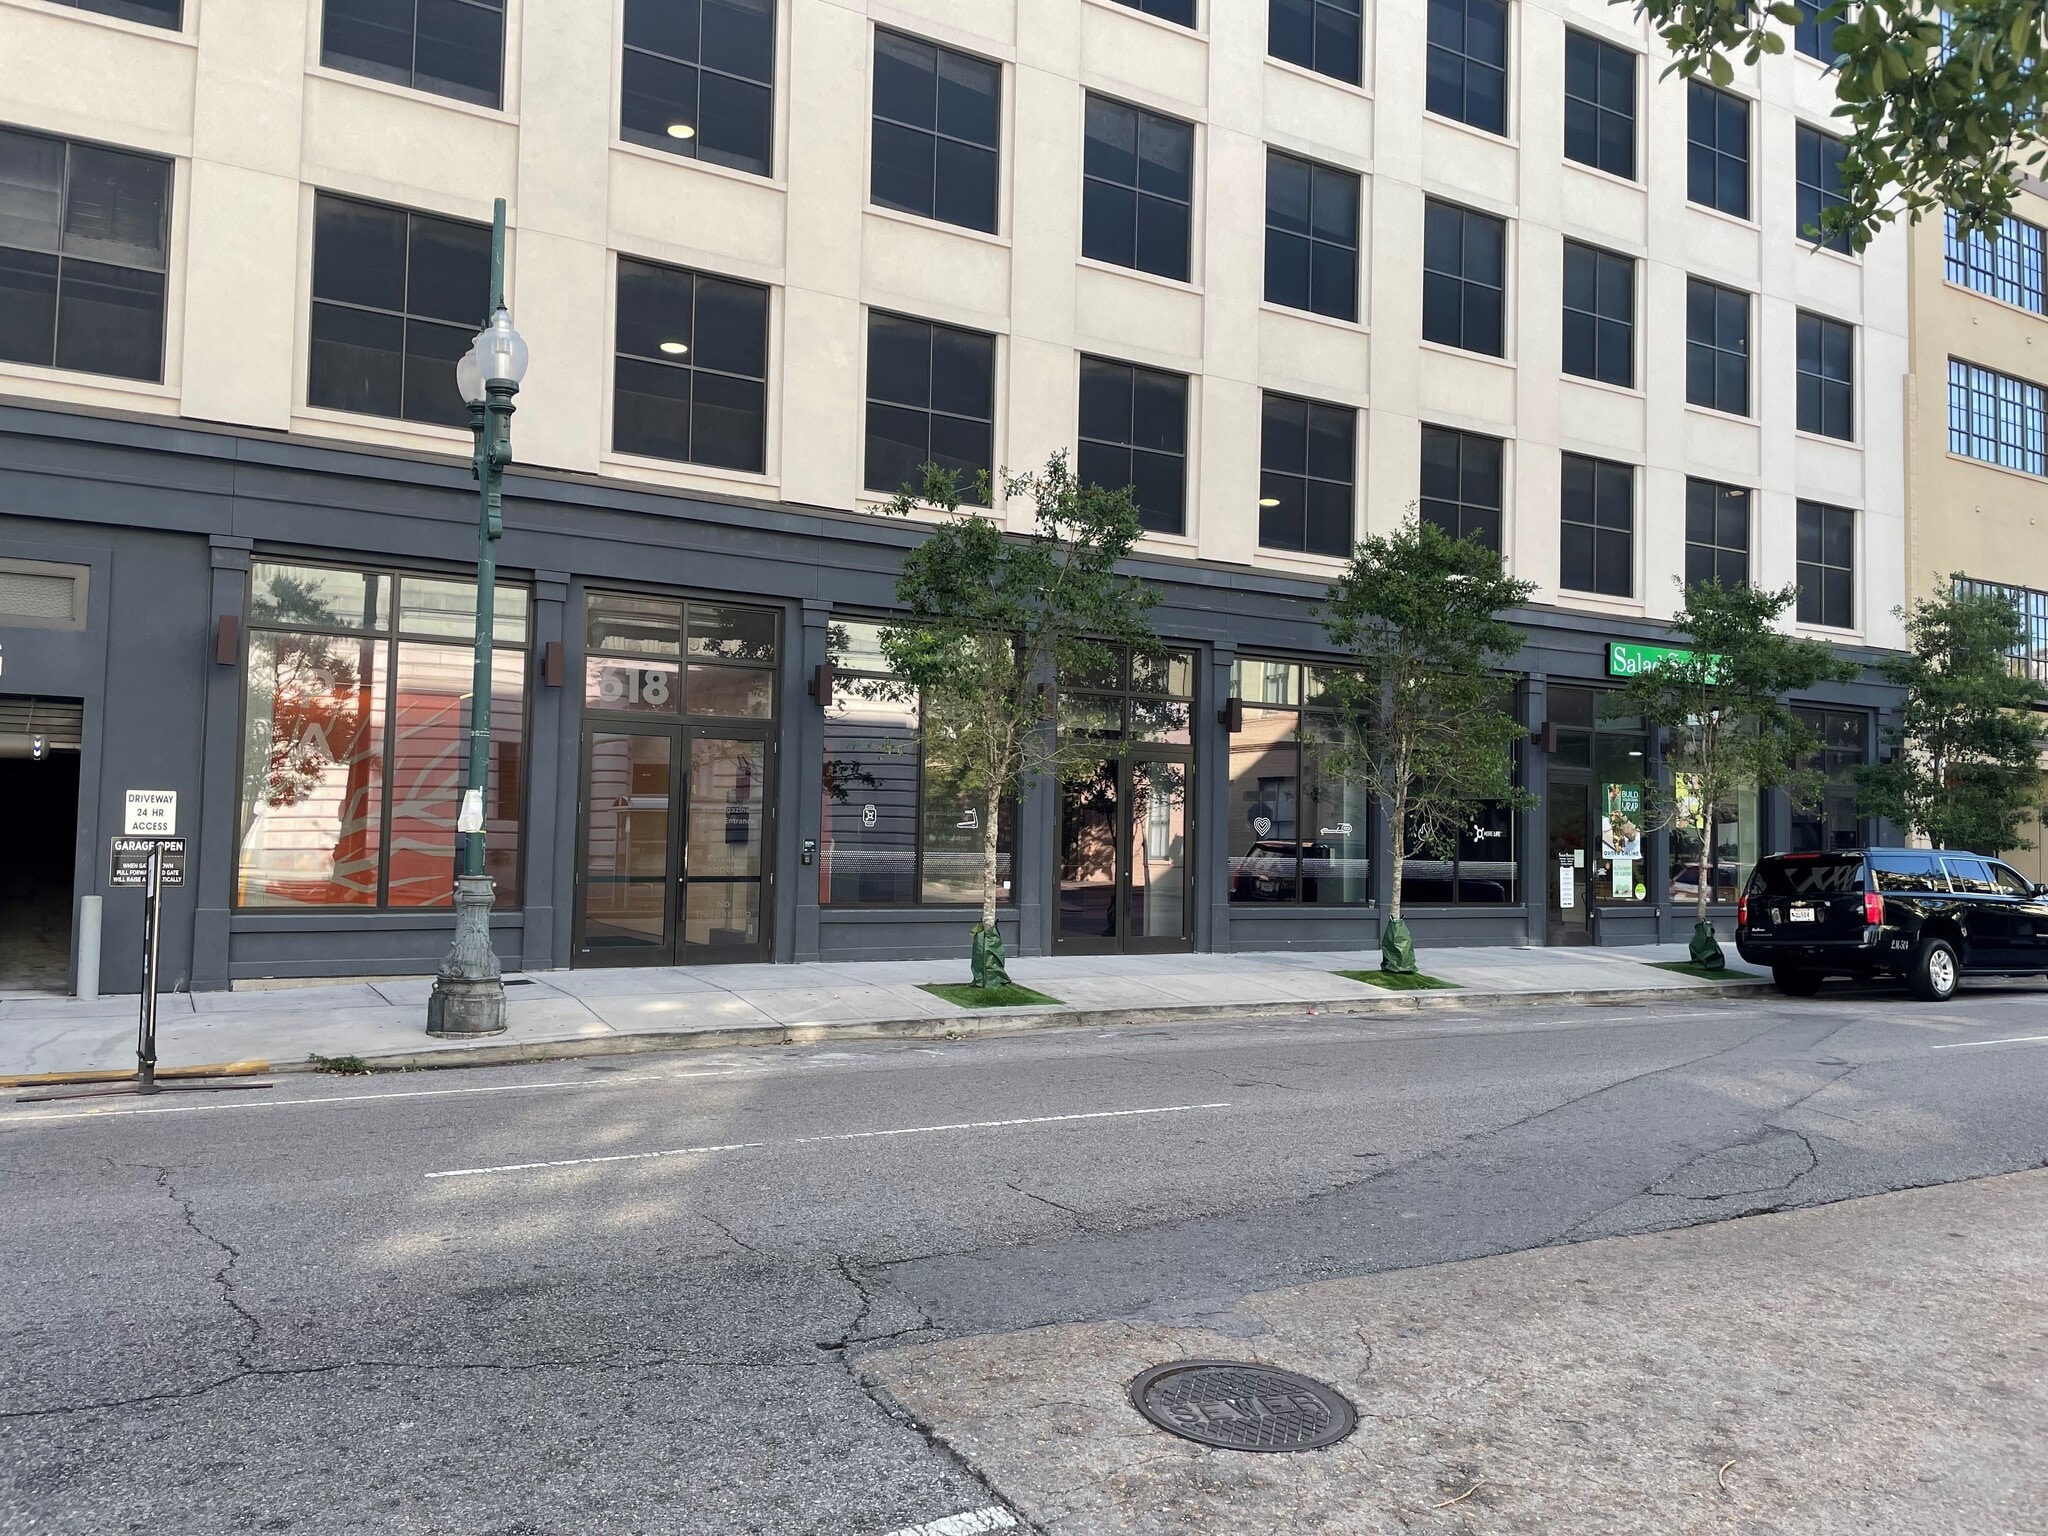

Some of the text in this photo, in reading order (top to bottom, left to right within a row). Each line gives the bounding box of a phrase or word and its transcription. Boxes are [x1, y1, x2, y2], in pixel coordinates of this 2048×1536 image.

[598, 667, 669, 705] 618
[128, 794, 174, 804] DRIVEWAY
[1621, 790, 1639, 798] BUILD
[1621, 802, 1639, 812] WRAP
[137, 808, 164, 817] 24 HR
[132, 822, 168, 831] ACCESS
[114, 840, 155, 852] GARAGE
[1170, 1394, 1326, 1423] SEWER
